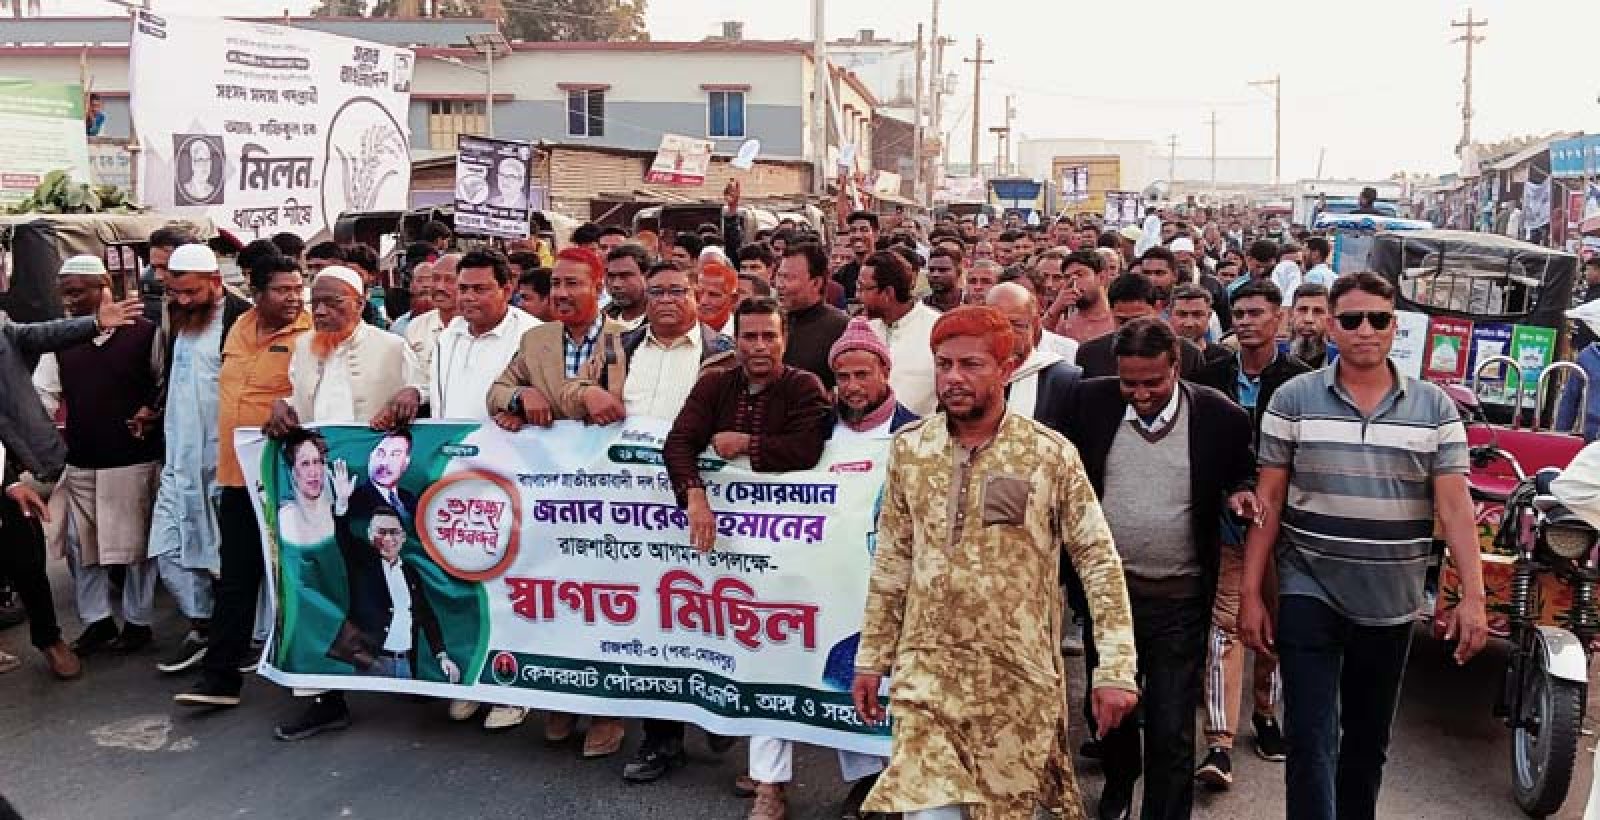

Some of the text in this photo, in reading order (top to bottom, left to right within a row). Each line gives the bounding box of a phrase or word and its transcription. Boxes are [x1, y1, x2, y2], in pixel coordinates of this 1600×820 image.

[239, 143, 314, 190] মিলন
[233, 207, 279, 229] ধানের
[561, 468, 632, 489] জাতীয়তাবাদী
[725, 481, 838, 505] চেয়ারম্যান
[533, 499, 827, 544] জনাব তারেক হমানের
[556, 533, 643, 560] রাজশাহীতে
[647, 541, 701, 567] আগমন
[503, 568, 820, 652] স্বাগত মিছিল
[521, 654, 599, 689] কেশরহাট
[603, 664, 684, 695] পৌরসভা
[754, 693, 798, 716] অঙ্গ
[801, 698, 816, 717] ও
